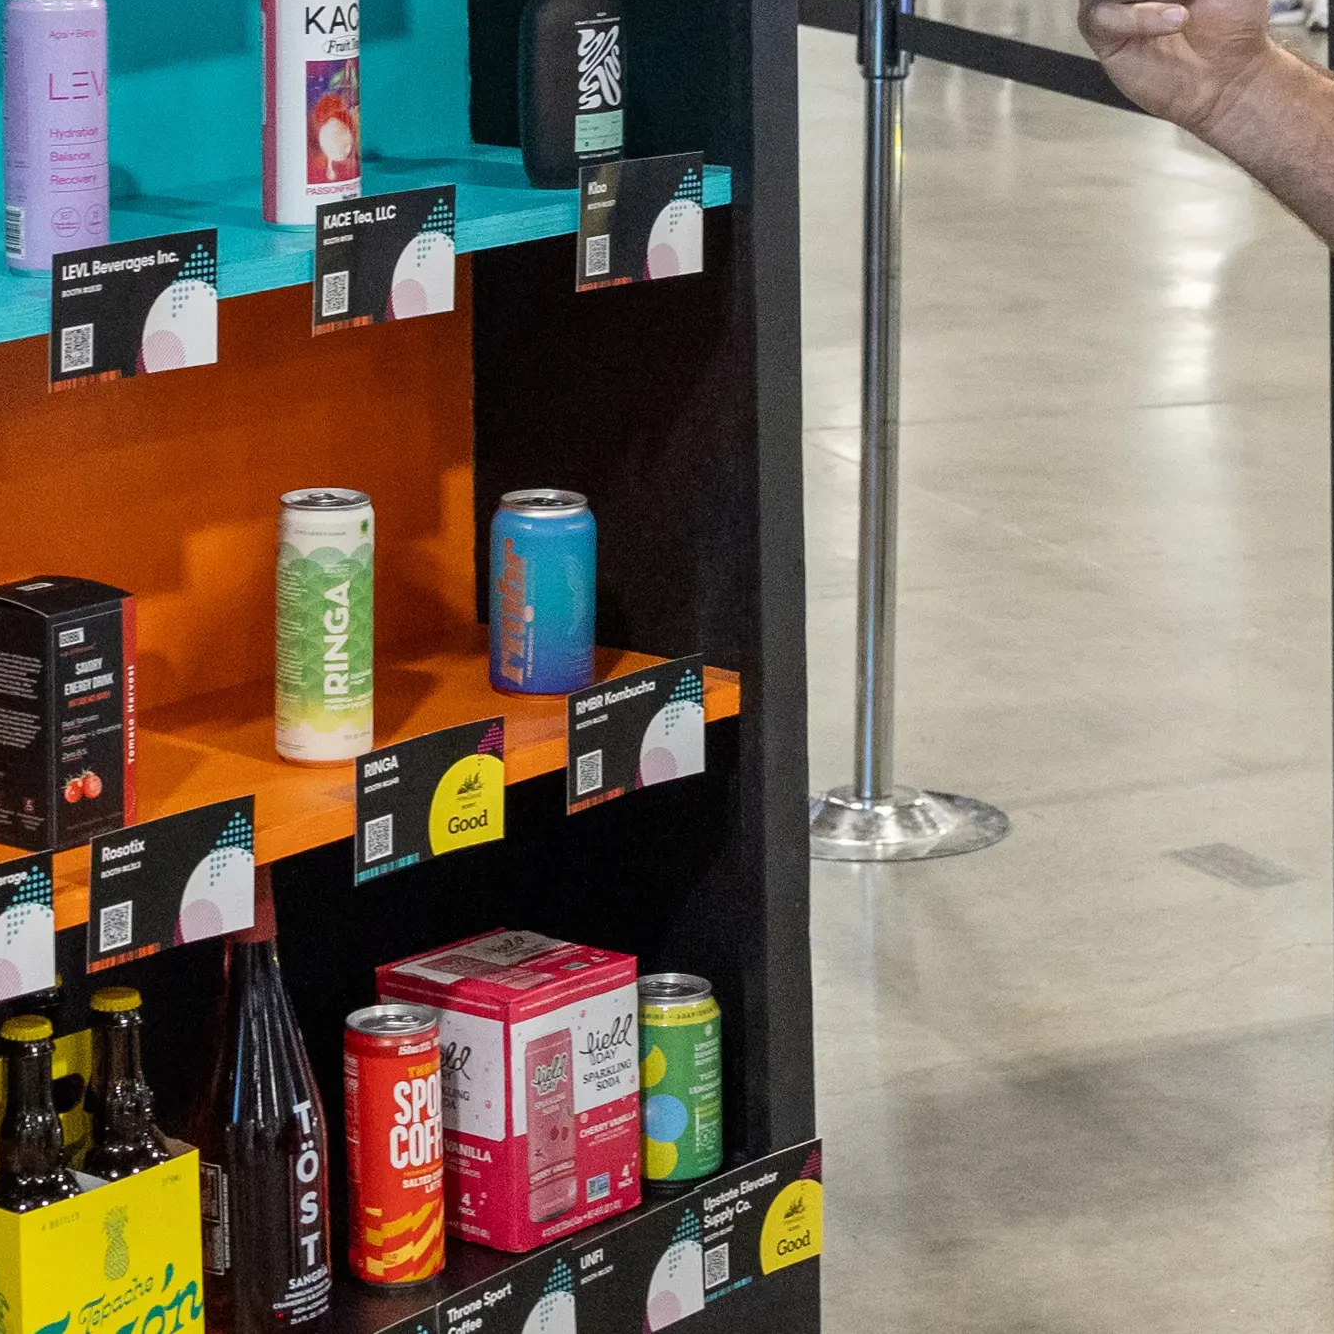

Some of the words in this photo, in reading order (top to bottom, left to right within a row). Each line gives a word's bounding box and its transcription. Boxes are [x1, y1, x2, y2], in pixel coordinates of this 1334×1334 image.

[326, 37, 349, 55] Fruit
[49, 126, 99, 140] Hydration
[49, 151, 91, 163] Balance
[50, 174, 98, 187] Recovery
[323, 213, 352, 230] KACE
[353, 209, 374, 225] Tea,
[375, 205, 397, 222] LLC
[62, 262, 90, 281] LEVL
[92, 254, 155, 275] Beverages
[157, 250, 179, 265] Inc.
[324, 580, 350, 695] RINGA
[575, 697, 603, 716] RMBR
[604, 680, 656, 705] Kombucha
[126, 719, 136, 765] Tomato
[364, 755, 399, 779] RINGA
[447, 809, 488, 835] Good
[101, 838, 146, 862] Rosotix
[597, 1048, 620, 1065] DAY
[583, 1059, 632, 1084] SPARKLING
[596, 1076, 621, 1092] SODA
[579, 1123, 609, 1139] CHERRY
[621, 1164, 630, 1178] 4
[293, 1100, 323, 1268] TÖST
[703, 1187, 739, 1212] Upstate
[740, 1171, 778, 1199] Elevator
[461, 1193, 471, 1206] 4
[703, 1208, 733, 1231] Supply
[734, 1201, 753, 1218] Co.
[776, 1232, 812, 1258] Good
[580, 1249, 604, 1271] UNFI
[447, 1299, 482, 1324] Throne
[483, 1283, 512, 1307] Sport
